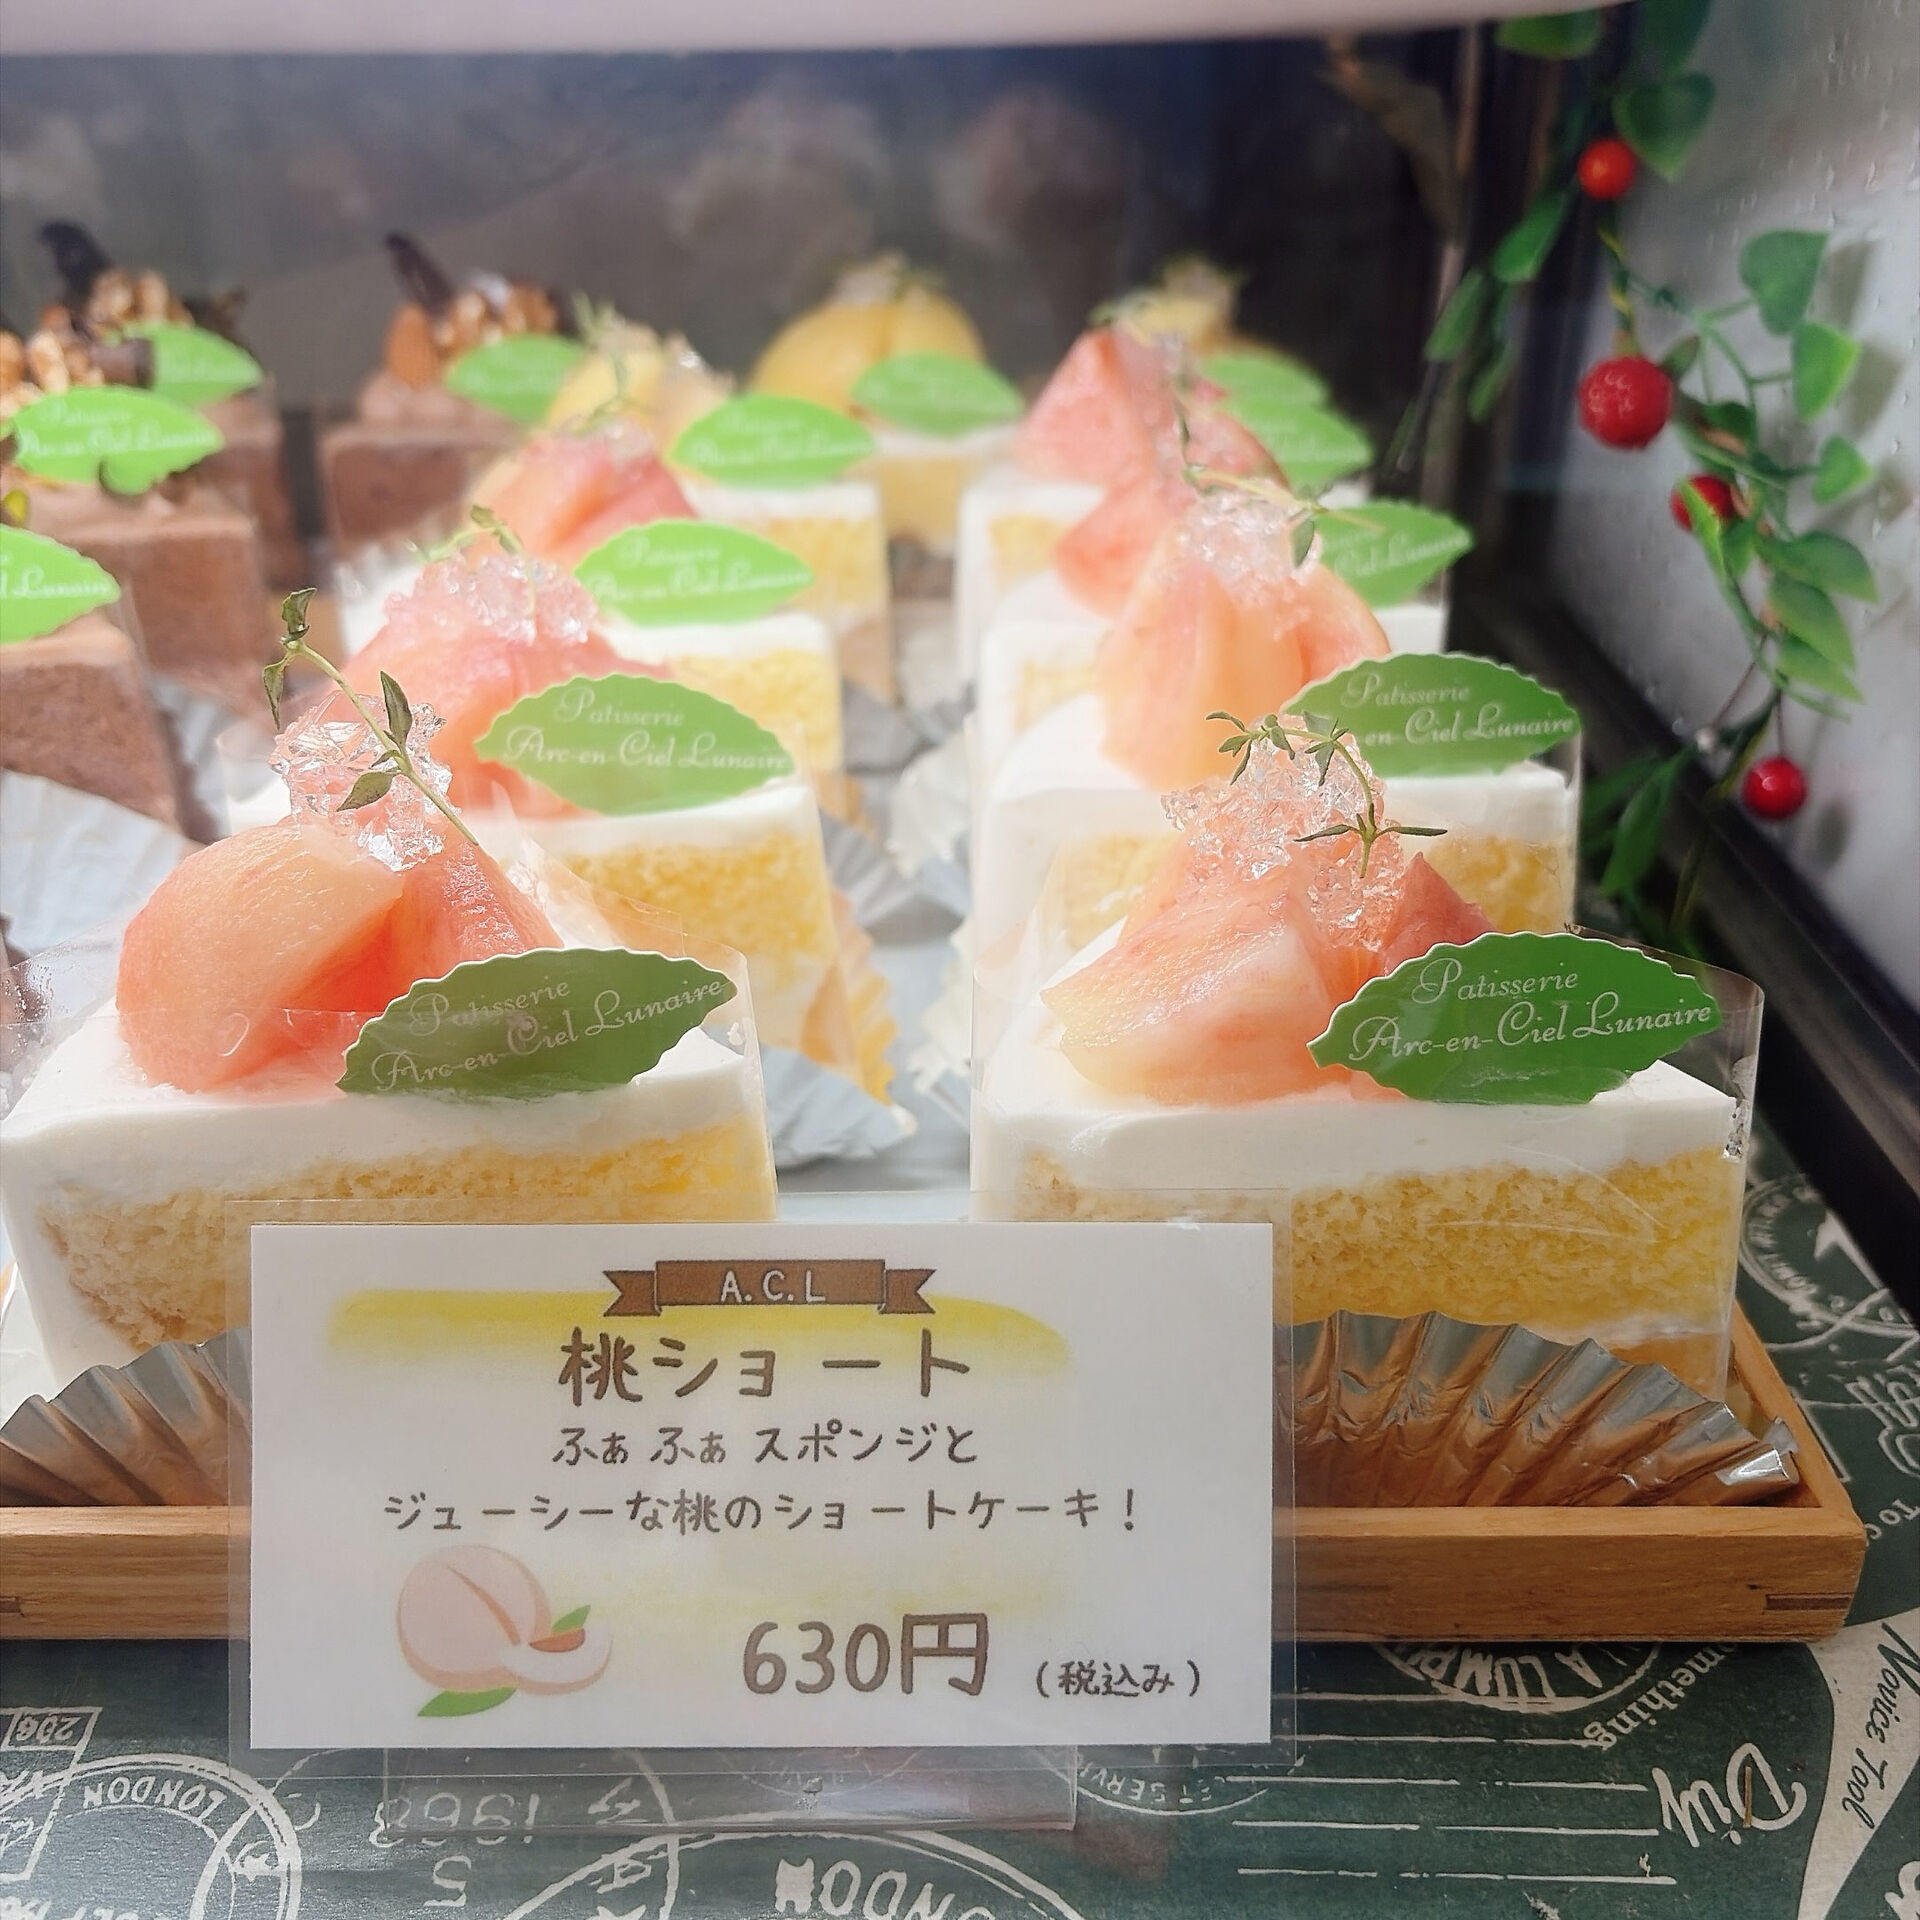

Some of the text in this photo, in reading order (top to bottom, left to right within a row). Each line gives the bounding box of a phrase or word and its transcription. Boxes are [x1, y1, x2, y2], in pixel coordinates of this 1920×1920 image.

[409, 976, 569, 1037] Patisserie
[585, 980, 724, 1036] Lunaire
[1412, 958, 1578, 1004] Patisserie
[1348, 991, 1711, 1061] Arc-en-Ciel Lunaire
[720, 1270, 827, 1303] A.C.L
[558, 1326, 970, 1406] 桃ショート
[743, 1612, 989, 1696] 630円
[83, 1775, 227, 1820] LONDON
[1842, 1748, 1888, 1829] Tool
